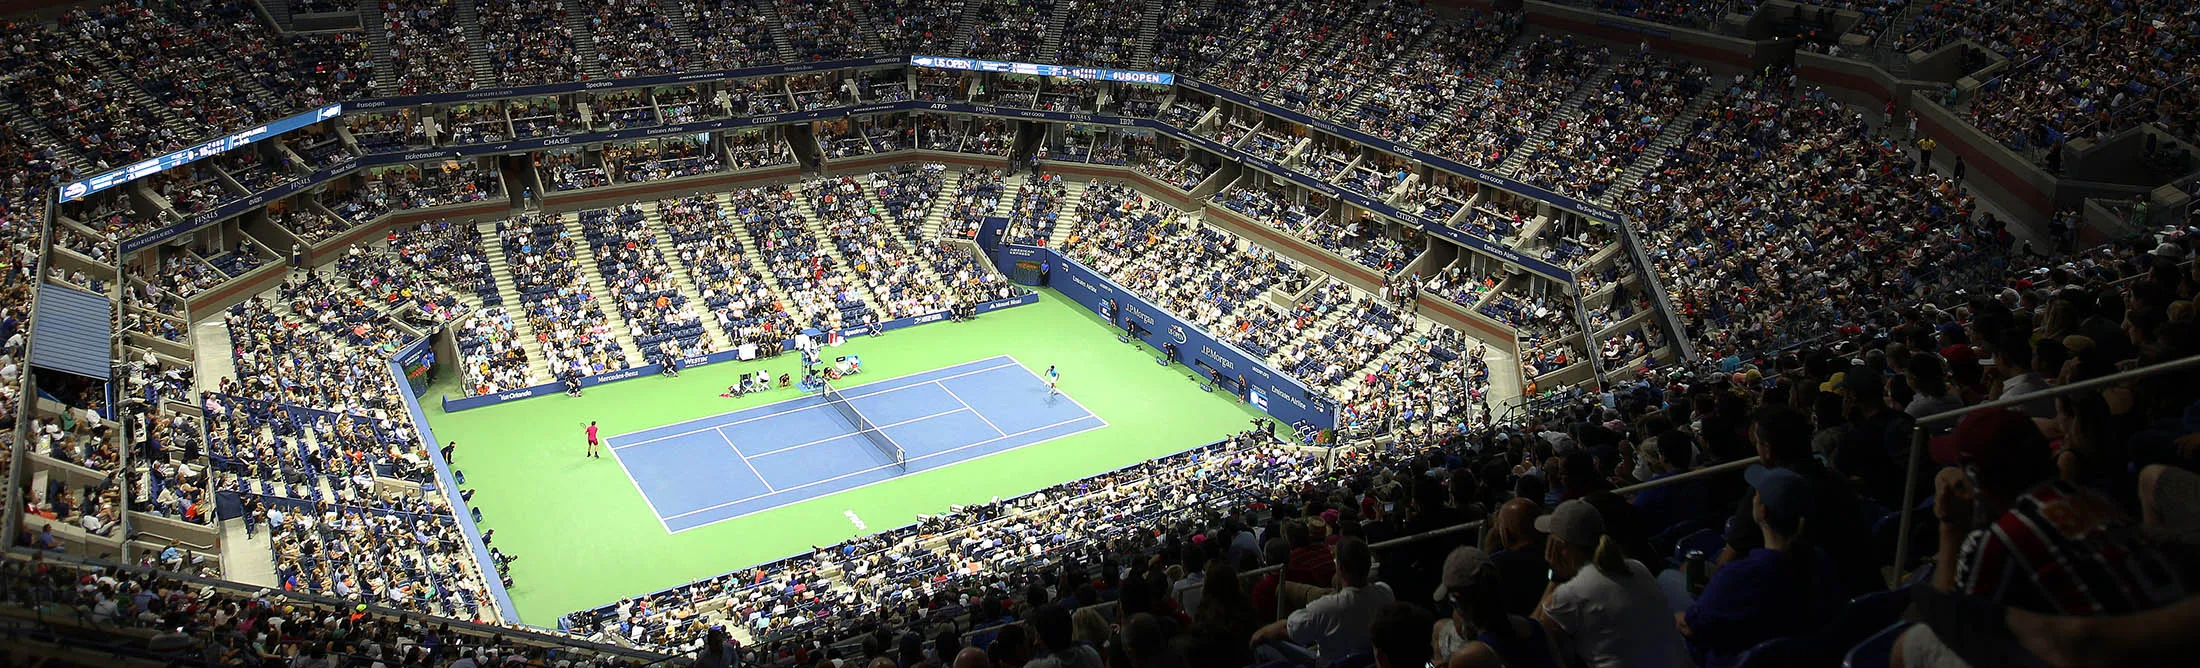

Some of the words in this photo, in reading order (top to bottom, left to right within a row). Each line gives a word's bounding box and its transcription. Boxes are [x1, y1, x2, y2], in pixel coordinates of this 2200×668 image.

[934, 58, 945, 68] US
[945, 59, 971, 69] OPEN
[356, 100, 386, 109] #usopen
[752, 115, 778, 124] CITIZEN
[1119, 118, 1135, 126] IBM
[543, 137, 570, 146] CHASE
[405, 151, 446, 161] ticketmaster
[1393, 146, 1414, 157] CHASE
[1396, 211, 1419, 225] CITIZEN
[598, 370, 639, 383] Mercedes-Benz
